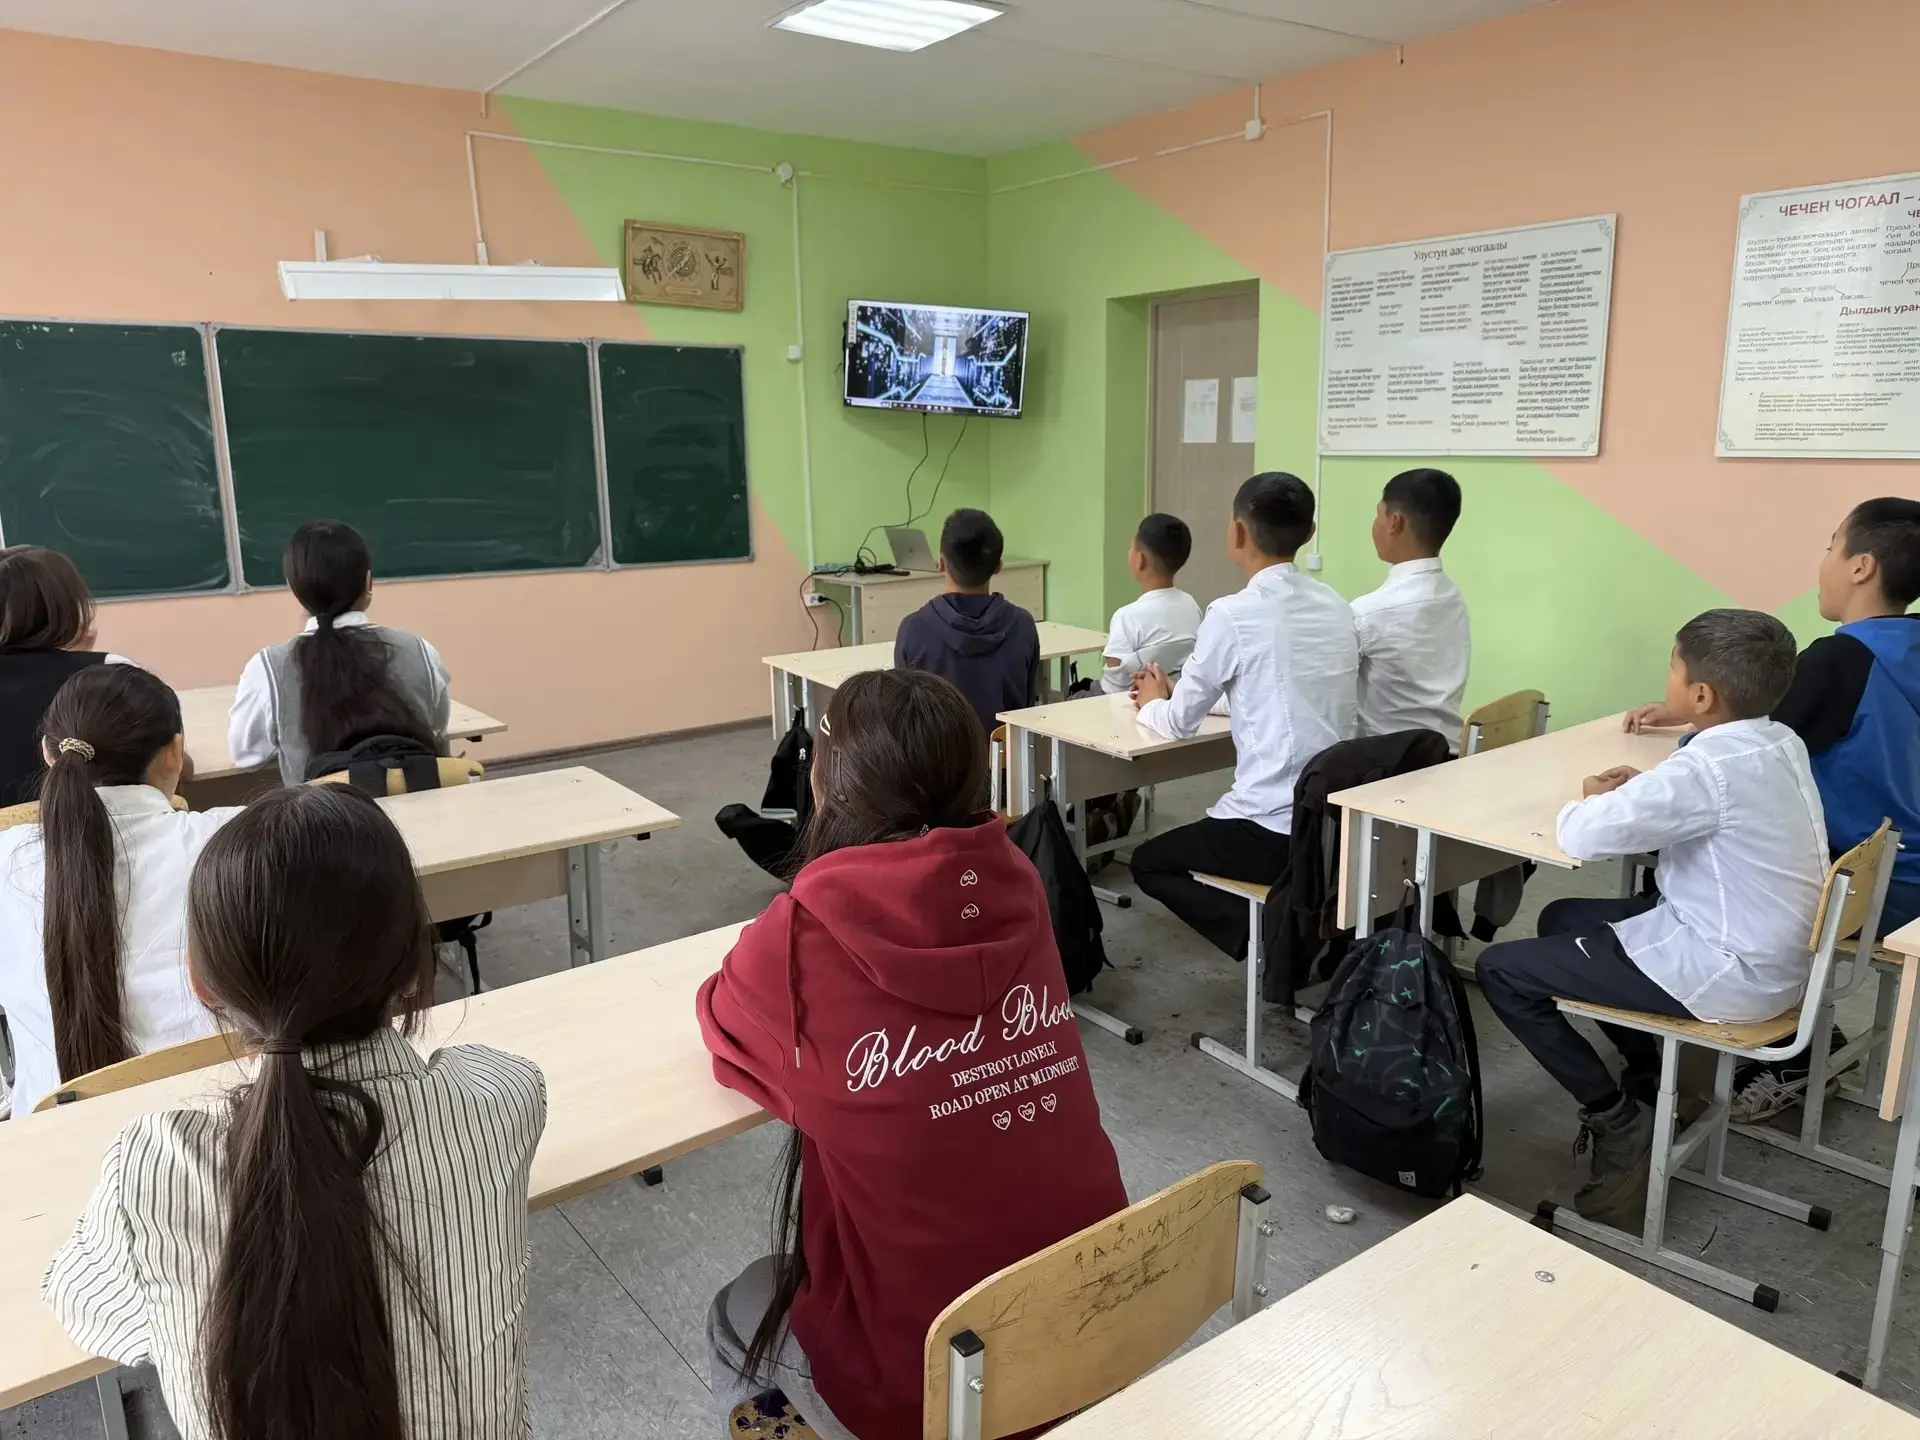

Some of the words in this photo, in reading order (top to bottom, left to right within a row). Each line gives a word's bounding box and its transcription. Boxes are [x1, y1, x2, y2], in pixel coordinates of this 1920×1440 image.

[1779, 200, 1829, 217] ЧЕЧЕН
[1835, 192, 1900, 210] ЧОГААЛ
[1450, 247, 1465, 256] аас
[1468, 242, 1507, 254] чогаалы
[1840, 305, 1891, 317] Дылдың
[846, 1014, 985, 1092] Blood
[950, 1057, 1013, 1088] DESTROY
[1013, 1040, 1058, 1068] LONELY
[929, 1095, 973, 1120] ROAD
[974, 1082, 1011, 1105] OPEN
[1013, 1075, 1032, 1093] AT
[1029, 1055, 1080, 1086] MIDNIGHT
